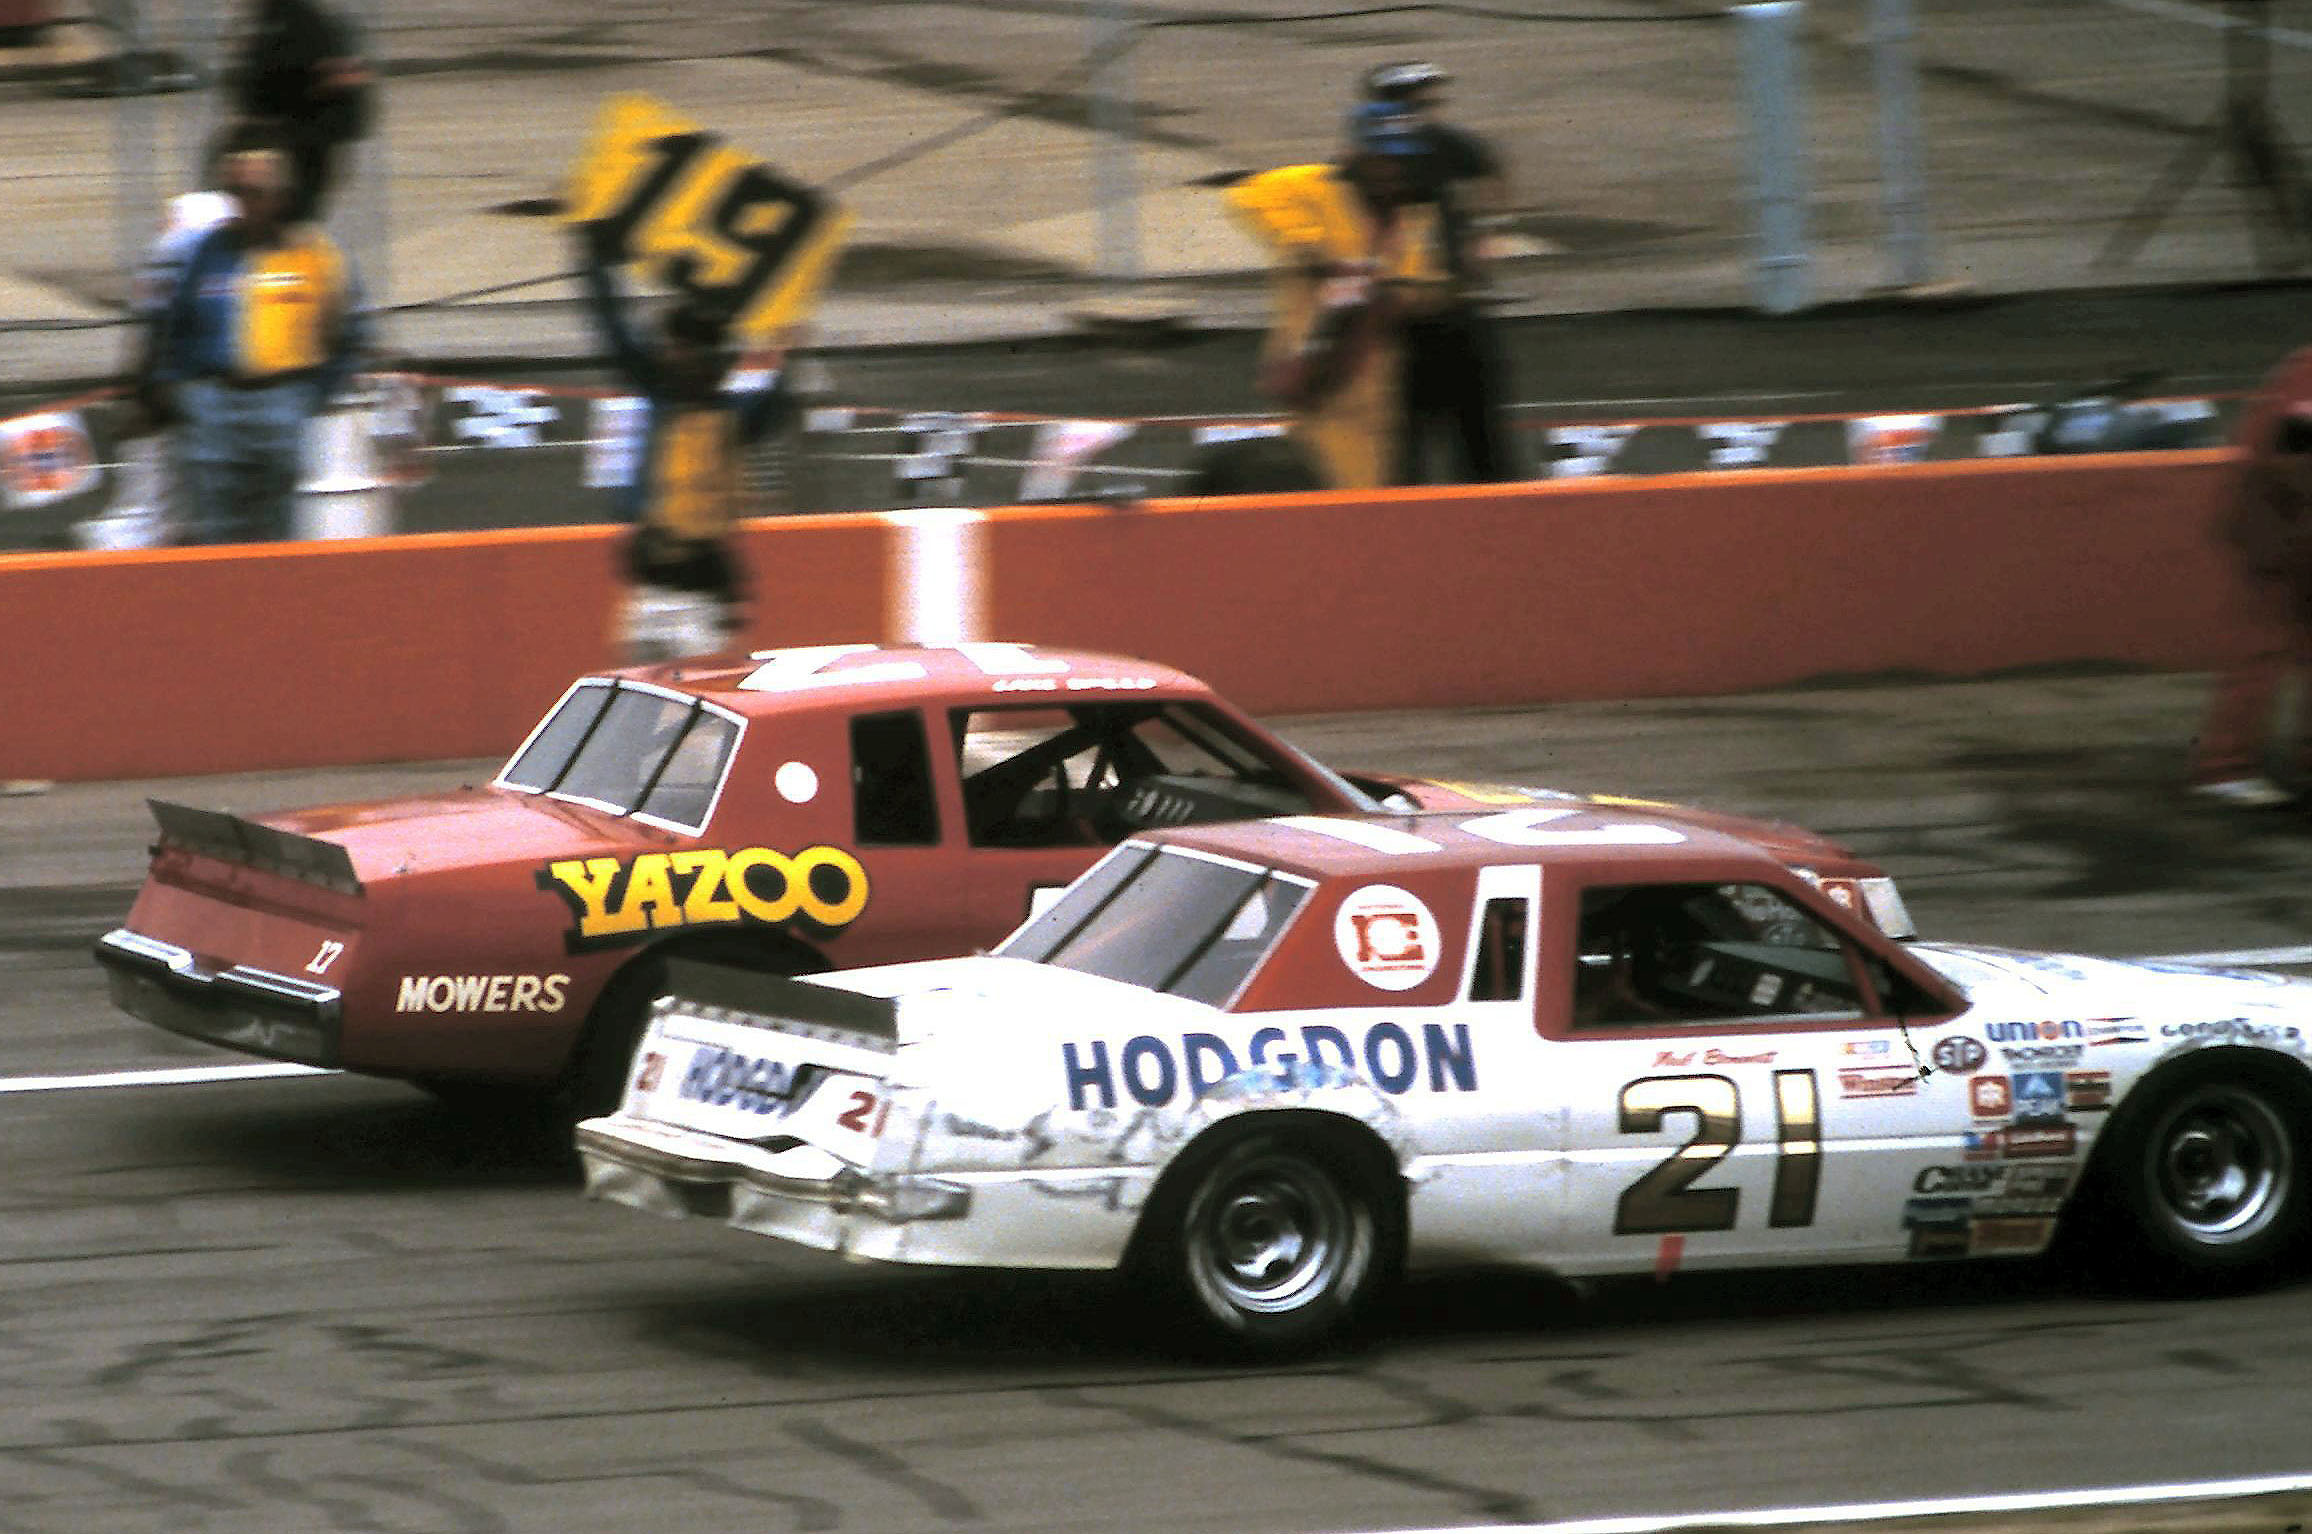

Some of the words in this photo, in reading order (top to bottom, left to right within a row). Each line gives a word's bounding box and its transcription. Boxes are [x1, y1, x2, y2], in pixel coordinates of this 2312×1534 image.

[572, 130, 825, 306] 19
[549, 845, 870, 938] YAZOO
[305, 940, 344, 974] 17
[396, 974, 571, 1013] MOWERS
[1938, 1036, 1980, 1068] STP
[1985, 1020, 2082, 1042] union
[1063, 1021, 1478, 1111] HODGDON
[836, 1090, 893, 1139] 21
[1614, 1068, 1822, 1234] 21
